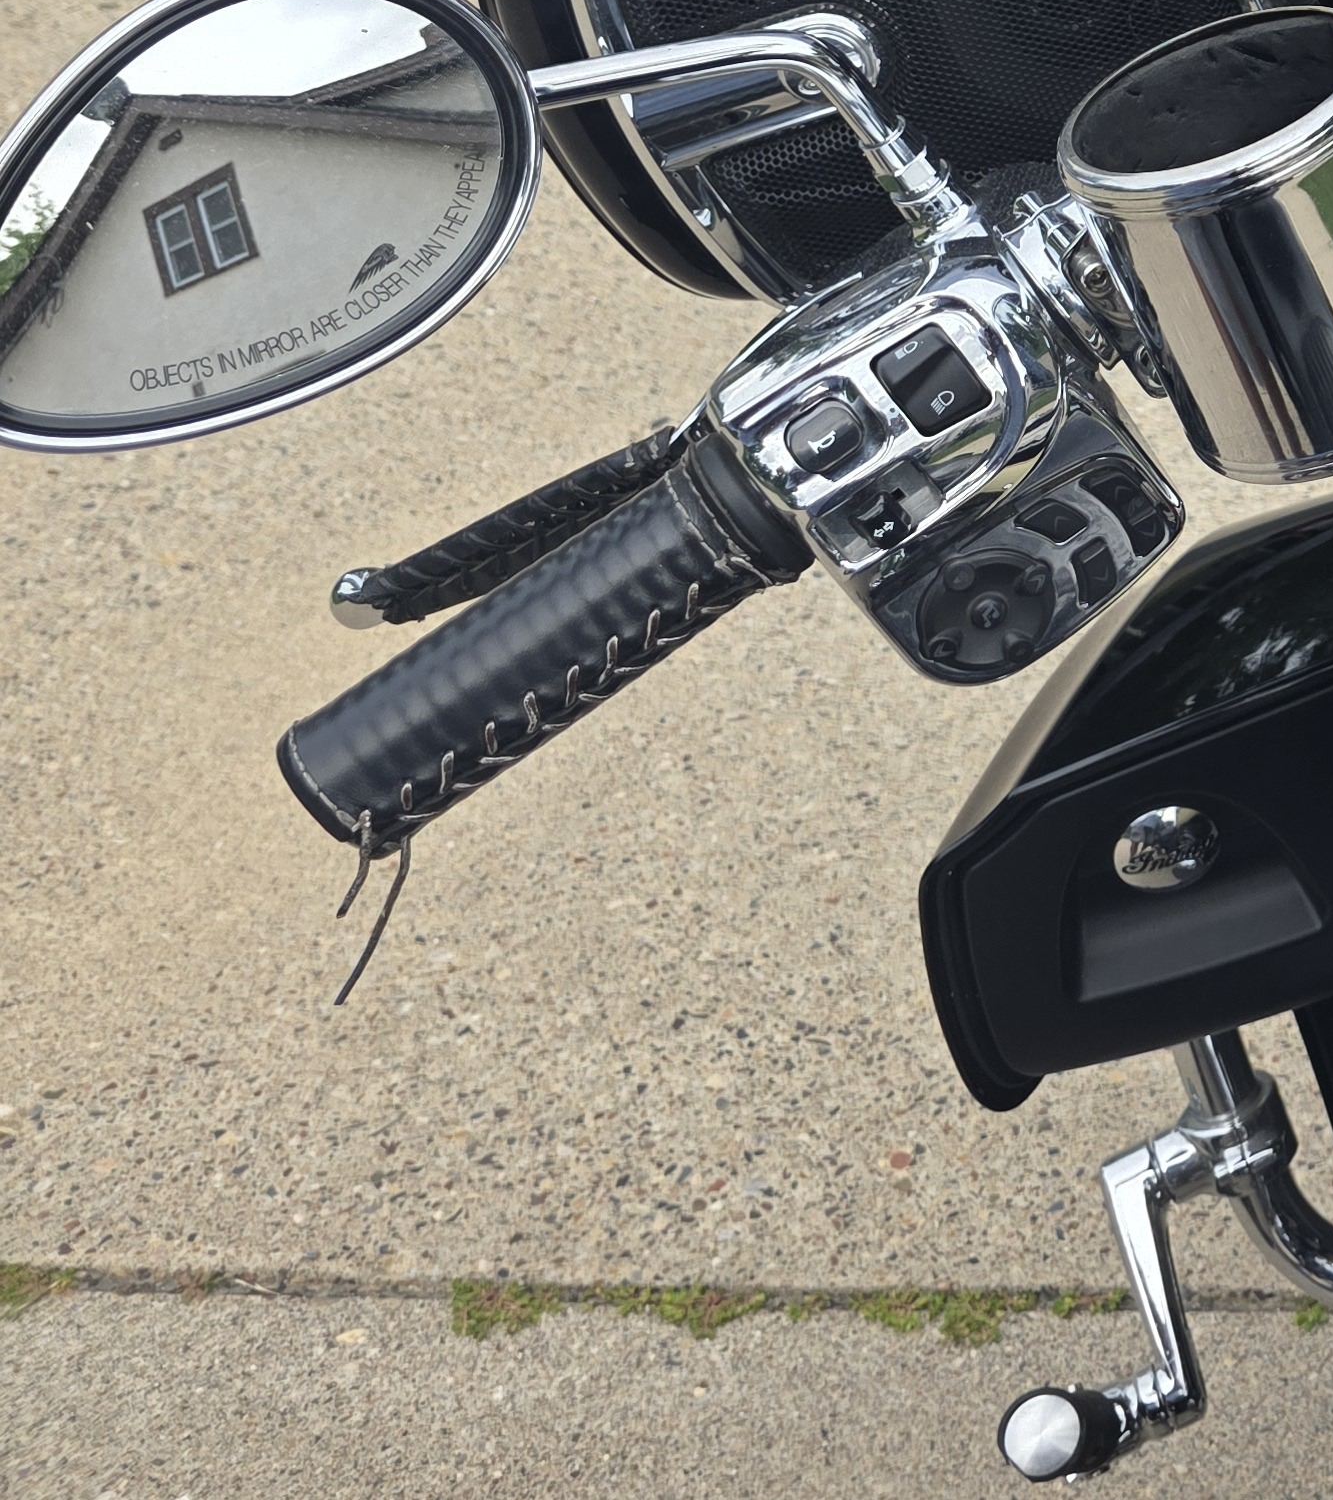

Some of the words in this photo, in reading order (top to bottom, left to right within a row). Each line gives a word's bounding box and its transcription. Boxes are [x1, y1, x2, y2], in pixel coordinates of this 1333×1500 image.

[130, 356, 214, 391] OBJECTS
[217, 350, 237, 373] IN
[237, 327, 309, 368] MIRROR
[309, 309, 348, 341] ARE
[345, 271, 410, 321] CLOSER
[400, 237, 447, 277] THAN
[433, 199, 473, 240] THEY
[455, 141, 487, 203] APPEAR
